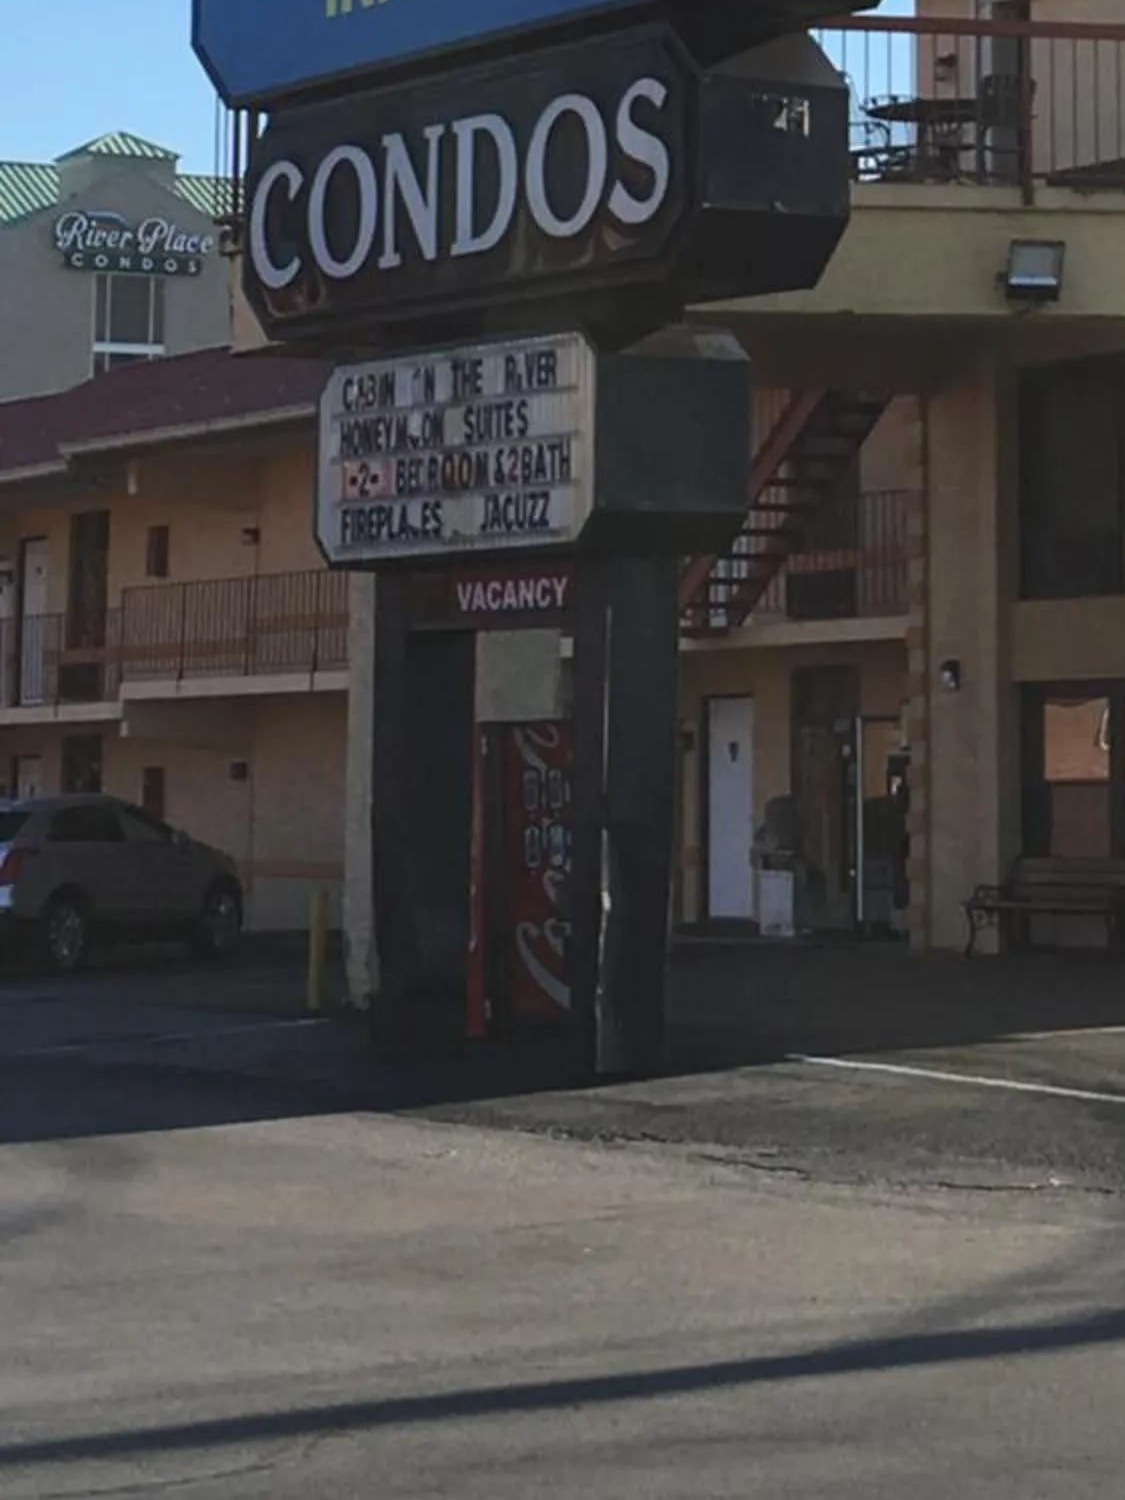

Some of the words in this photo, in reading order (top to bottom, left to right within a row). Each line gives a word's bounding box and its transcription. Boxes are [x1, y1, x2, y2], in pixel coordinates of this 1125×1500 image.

[250, 77, 669, 288] CONDOS
[55, 211, 133, 250] River
[137, 217, 214, 254] Place
[71, 252, 197, 273] CONDOS
[451, 358, 483, 400] THE
[464, 399, 529, 441] SUITES
[341, 500, 443, 543] FIREPLAES
[457, 576, 568, 612] VACANCY
